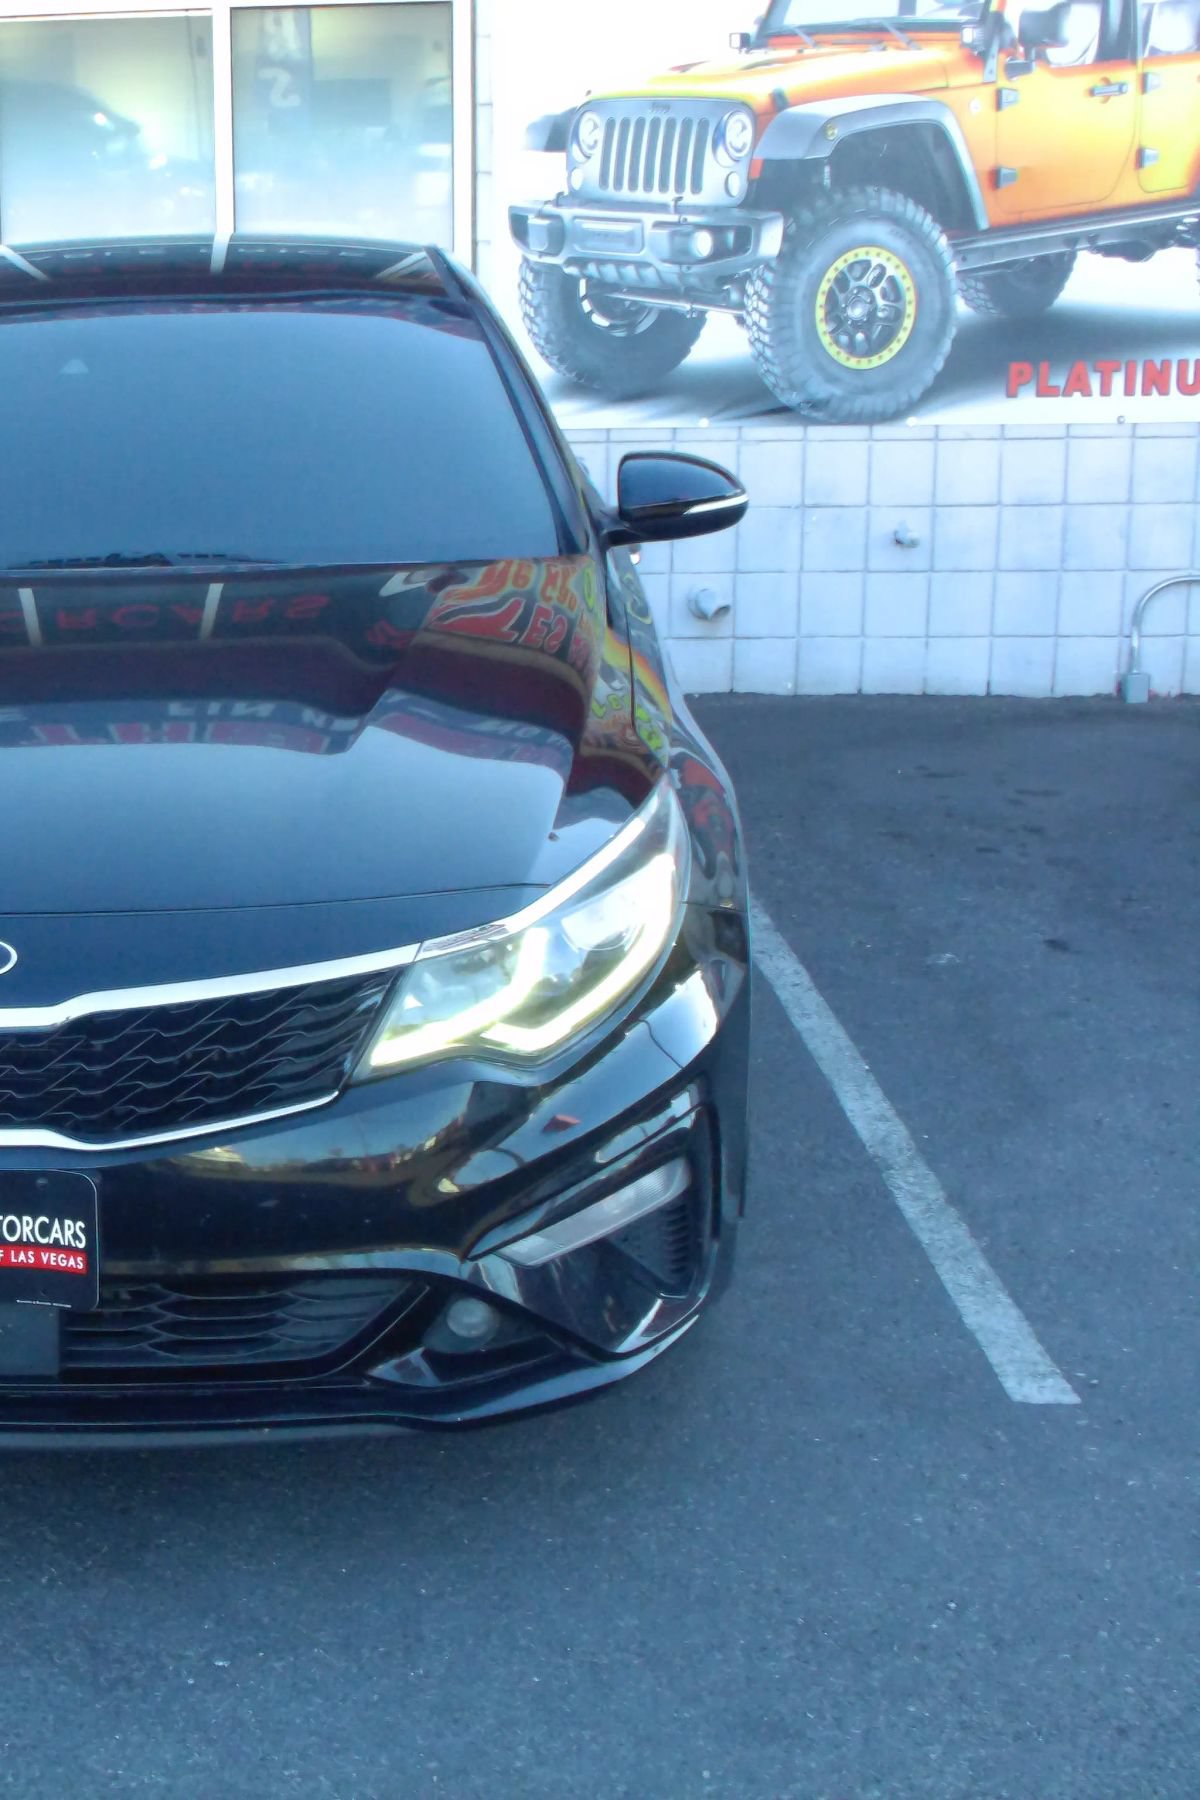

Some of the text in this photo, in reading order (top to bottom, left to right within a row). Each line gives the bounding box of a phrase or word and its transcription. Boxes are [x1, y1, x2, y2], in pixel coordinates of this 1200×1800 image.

[1006, 359, 1200, 398] PLATINU
[11, 1250, 35, 1264] LAS
[41, 1252, 84, 1270] VEGAS
